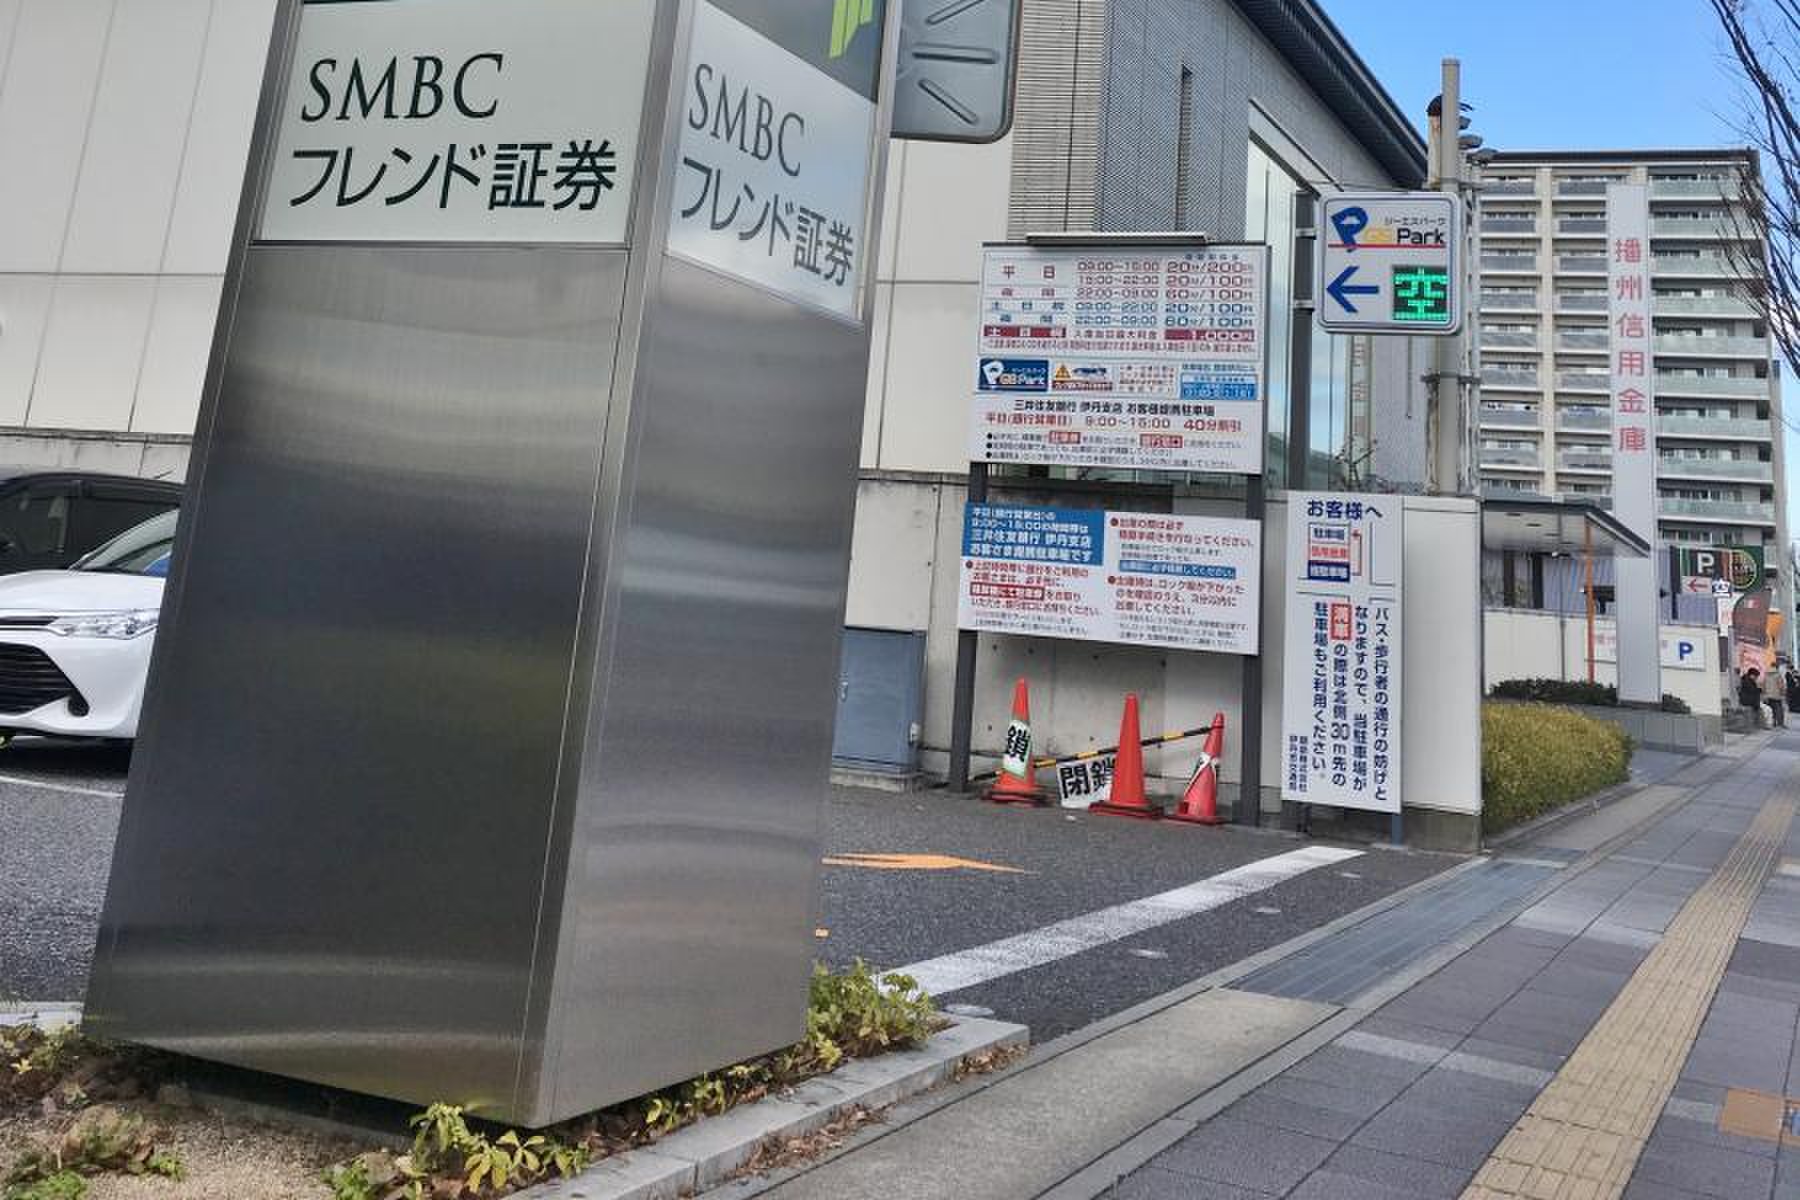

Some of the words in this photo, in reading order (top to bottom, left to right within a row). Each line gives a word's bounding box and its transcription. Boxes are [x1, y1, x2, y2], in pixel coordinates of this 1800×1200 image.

[300, 52, 504, 123] SMBC
[688, 62, 805, 178] SMBC
[289, 139, 618, 212] フレンド証券
[681, 155, 855, 287] フレンド証券
[1396, 227, 1445, 245] Park
[1393, 266, 1449, 321] 空
[1614, 238, 1647, 454] 播州信用金庫
[1013, 399, 1077, 413] 三井住友銀行
[1306, 499, 1384, 521] お客様へ
[1696, 551, 1715, 574] P
[1678, 641, 1695, 661] P
